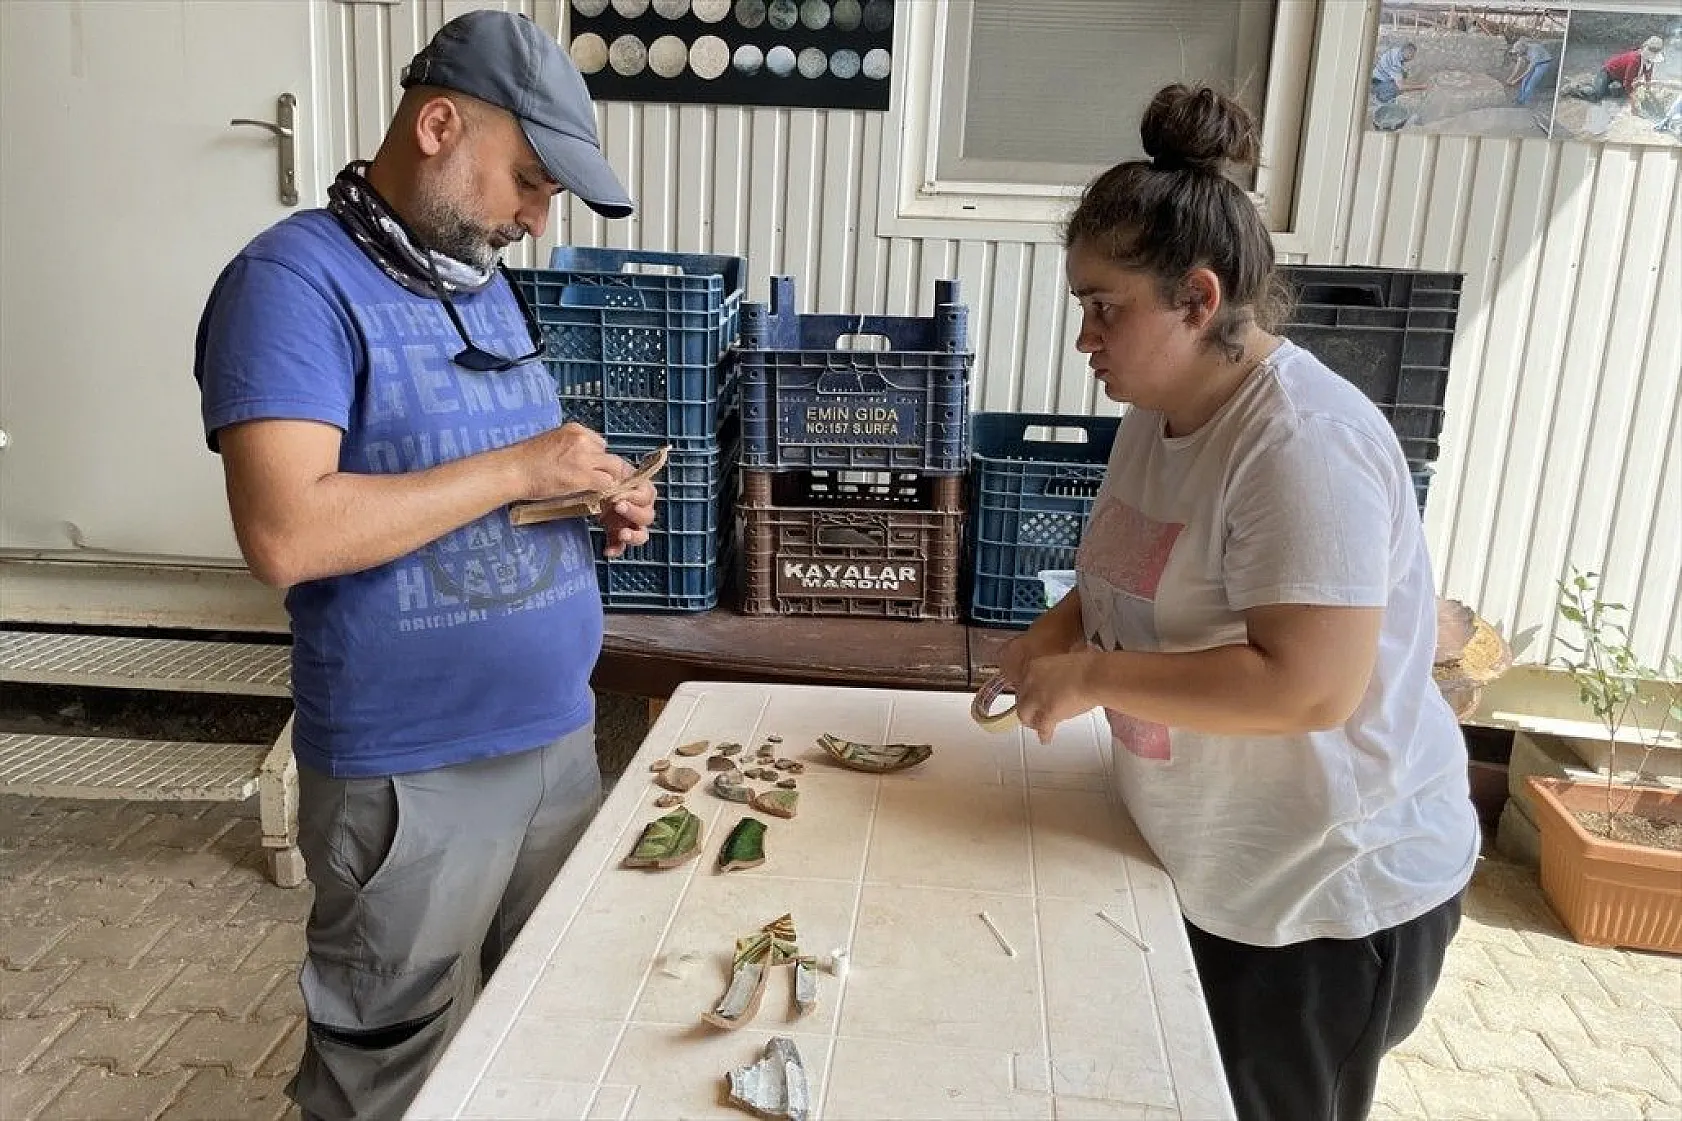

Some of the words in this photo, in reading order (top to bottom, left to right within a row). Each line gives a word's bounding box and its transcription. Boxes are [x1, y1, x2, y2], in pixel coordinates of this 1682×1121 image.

[806, 406, 849, 421] EMIN
[855, 406, 898, 421] GIDA
[806, 422, 848, 434] NO:157
[784, 561, 917, 581] KAYALAR
[801, 577, 900, 590] MARDIN
